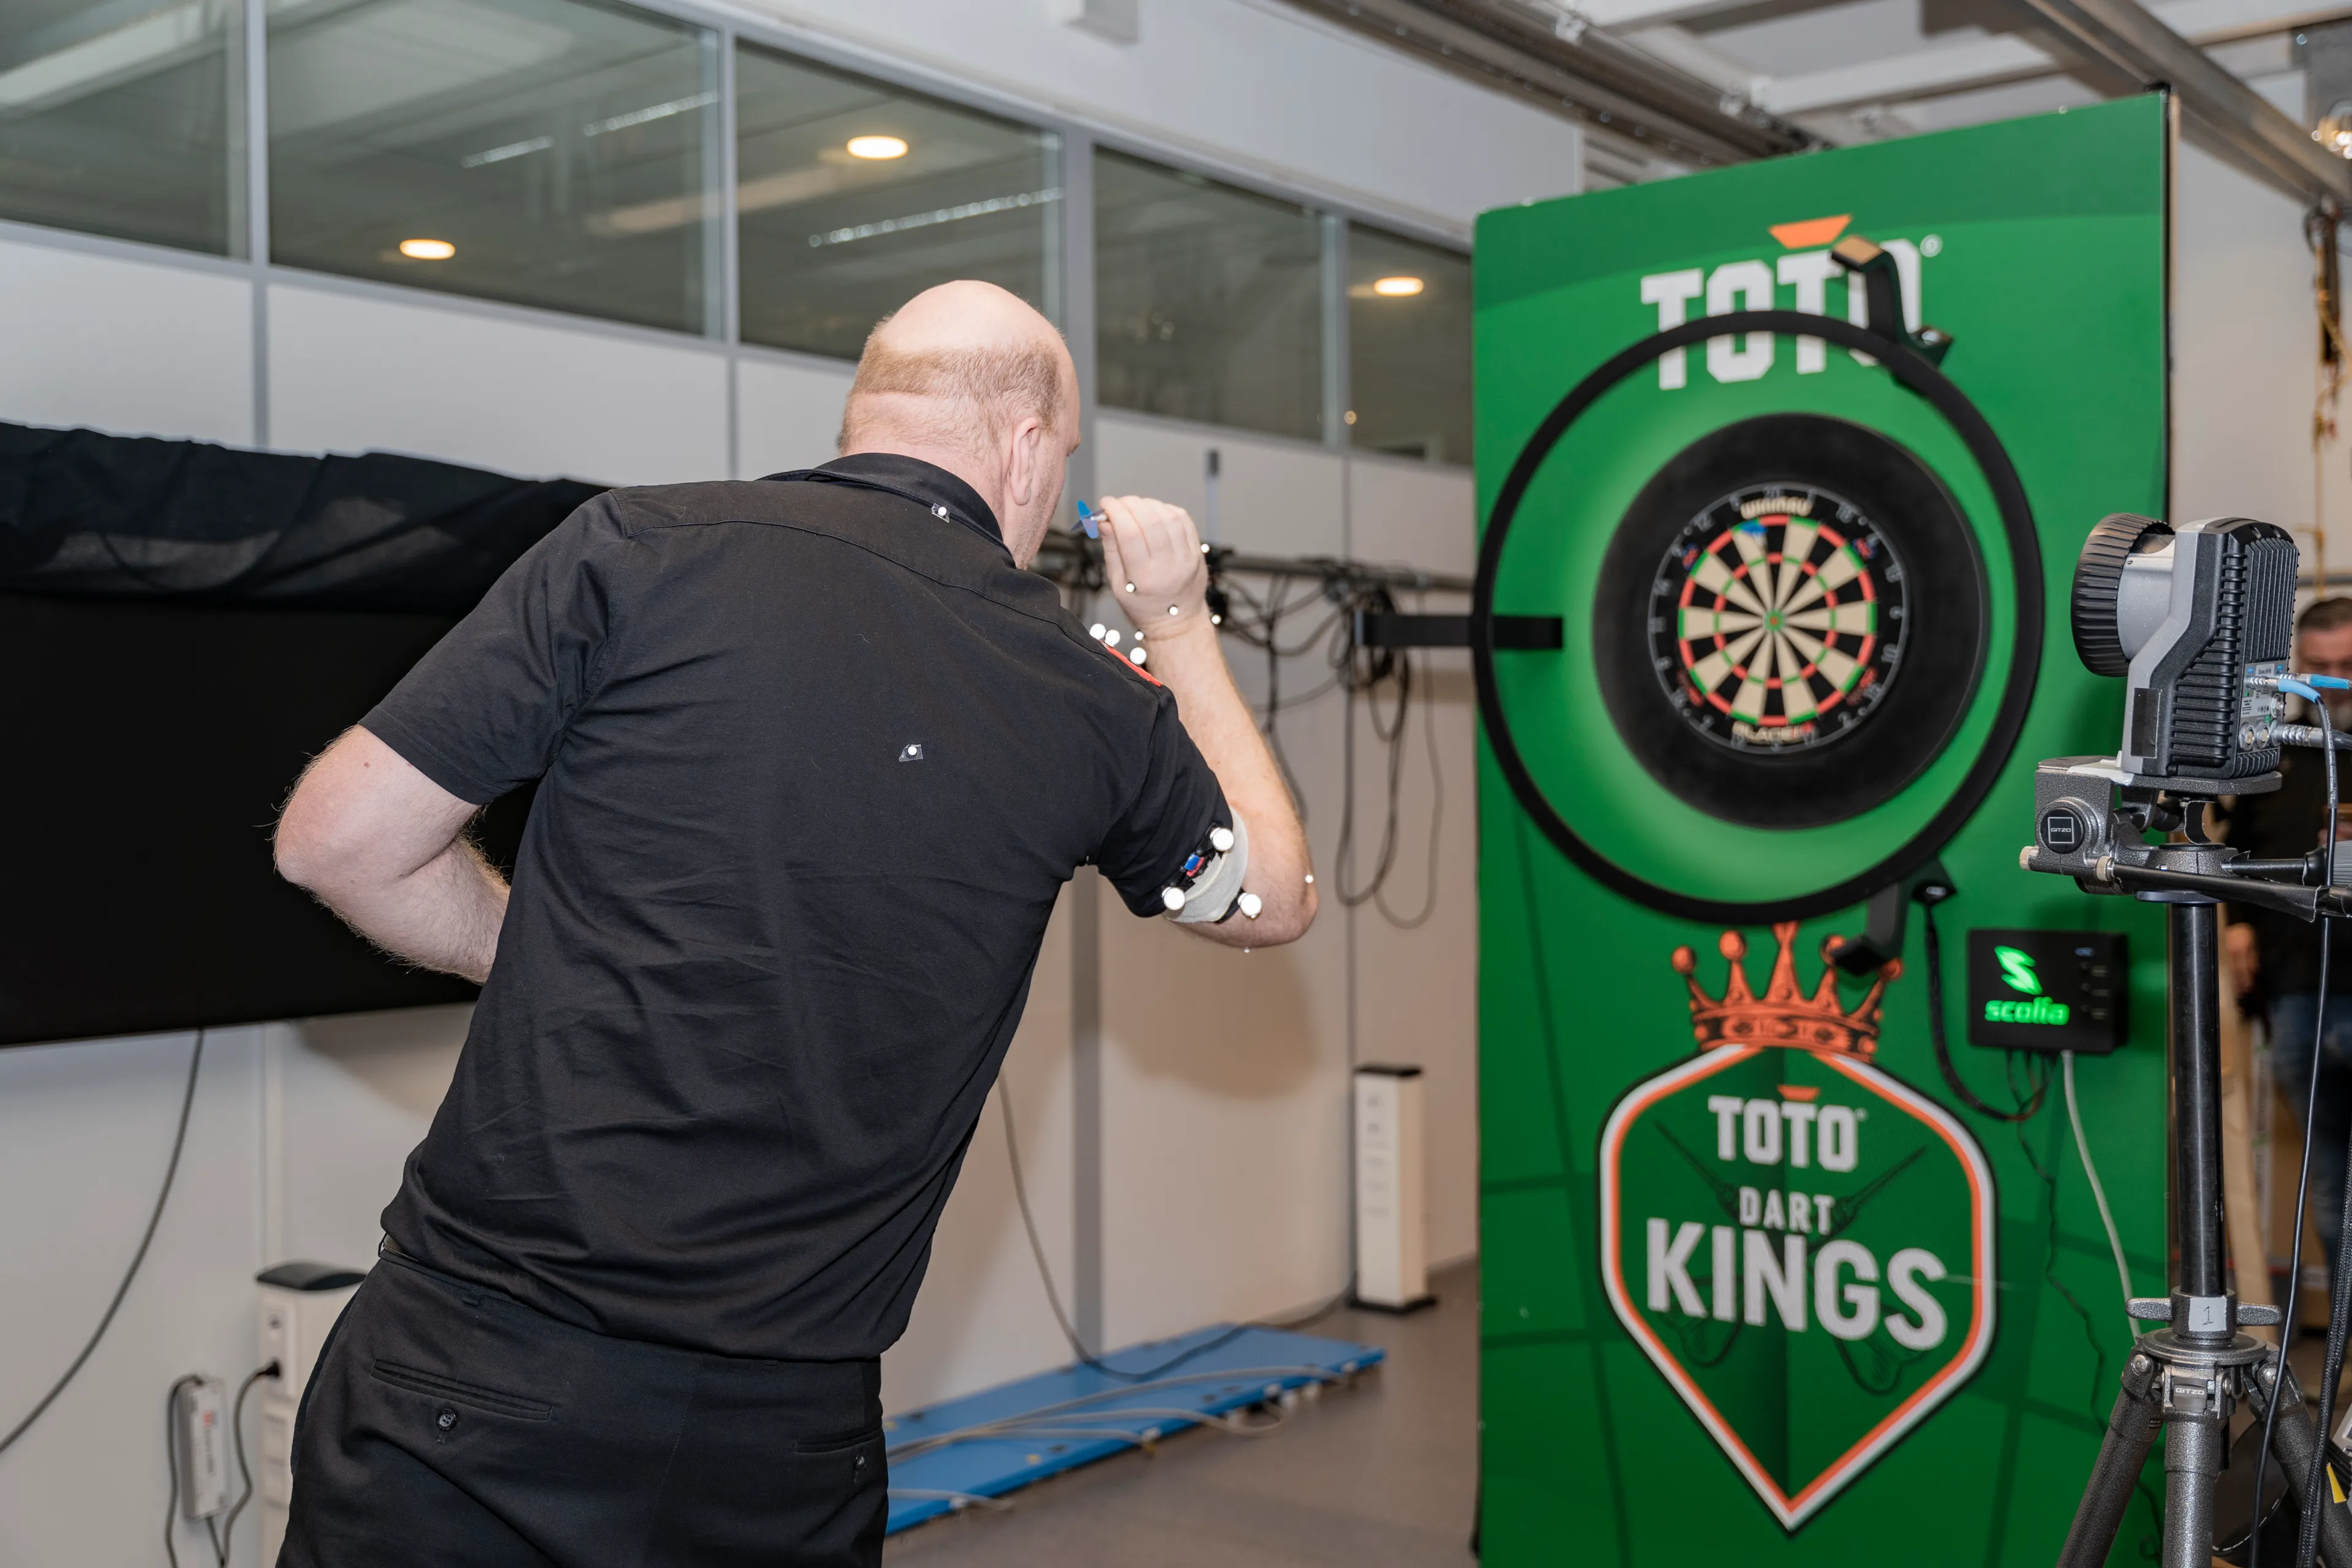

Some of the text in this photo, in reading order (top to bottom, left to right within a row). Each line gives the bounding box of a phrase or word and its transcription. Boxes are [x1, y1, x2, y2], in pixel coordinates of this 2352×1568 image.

[1985, 997, 2070, 1025] scolia
[1708, 1095, 1858, 1173] TOTO
[1739, 1186, 1834, 1235] DART
[1646, 1217, 1948, 1351] KINGS
[2202, 1306, 2214, 1326] 1
[2175, 1387, 2205, 1396] GITZO
